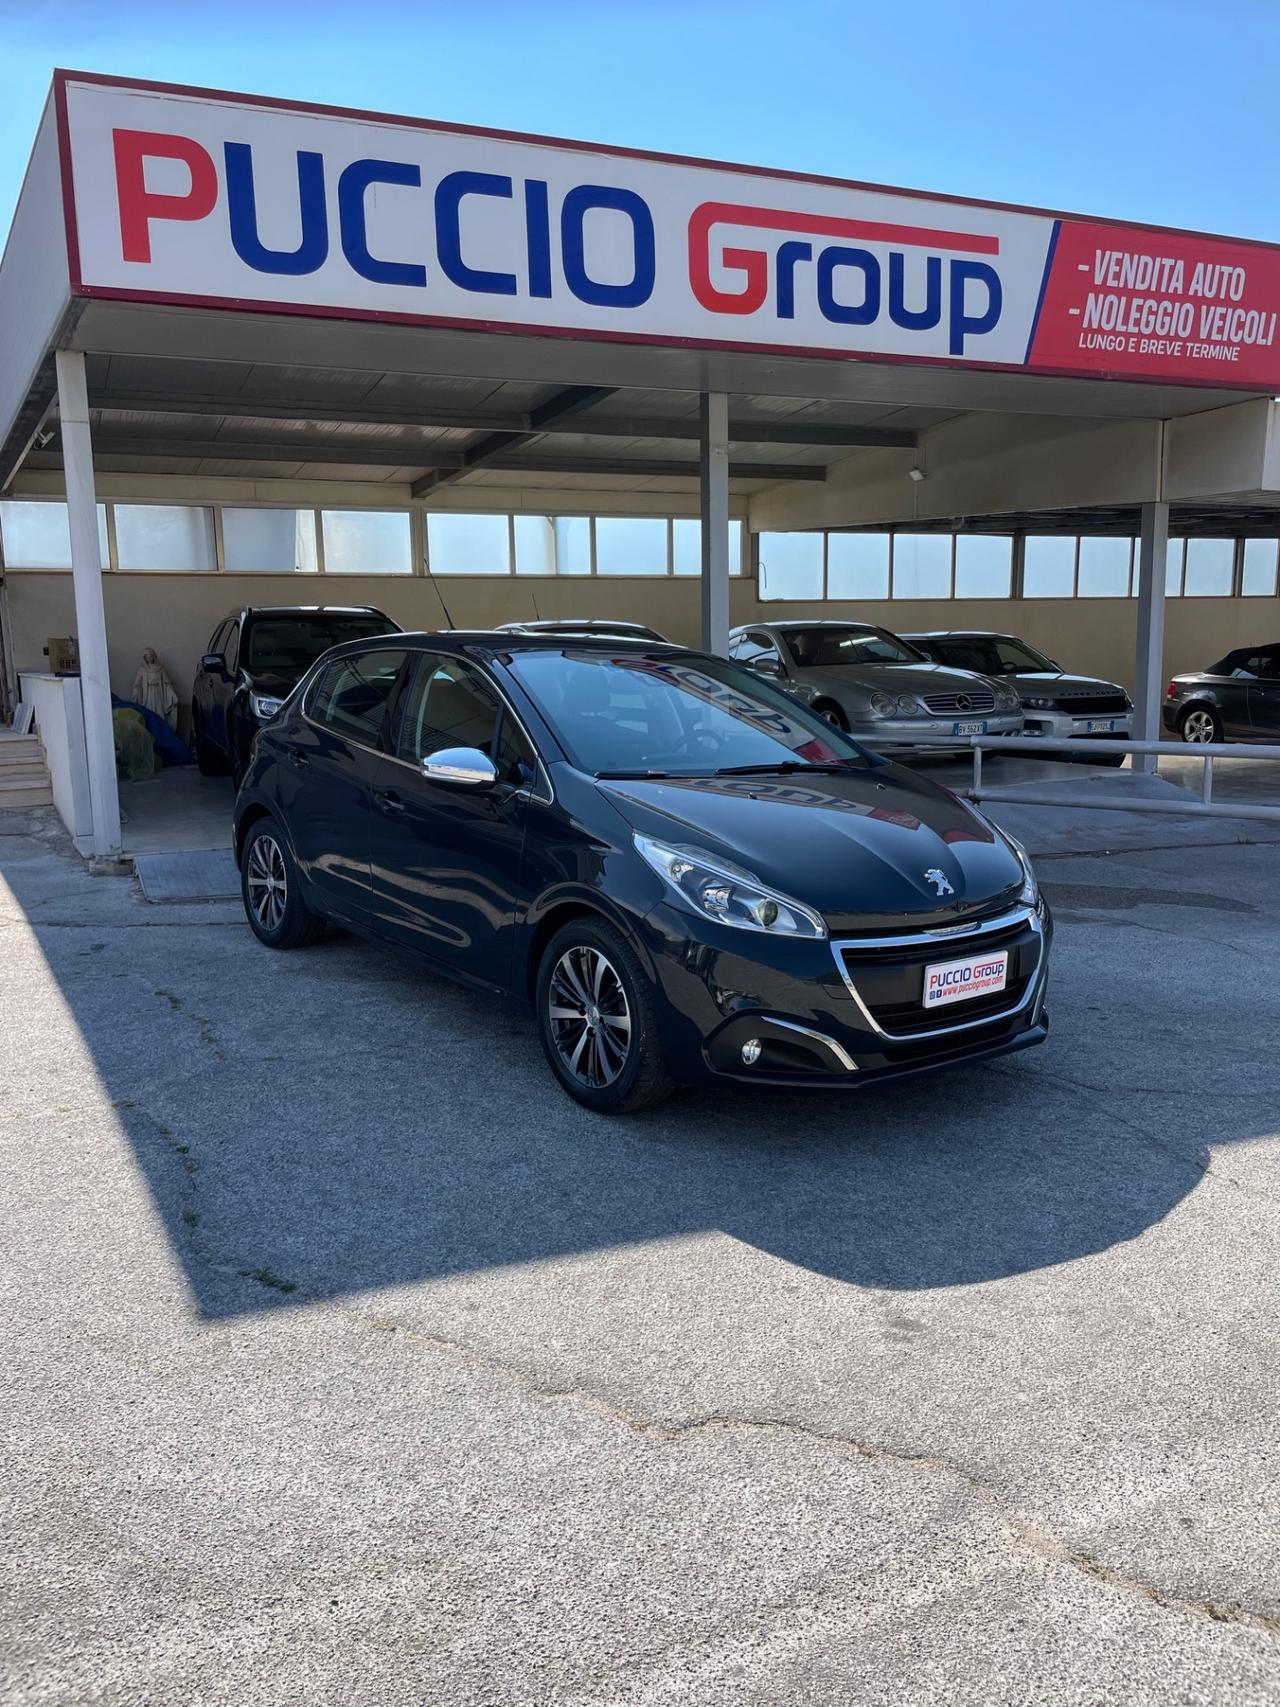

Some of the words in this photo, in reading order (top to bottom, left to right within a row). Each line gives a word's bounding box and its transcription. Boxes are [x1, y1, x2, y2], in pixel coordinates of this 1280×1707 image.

[113, 129, 656, 309] PUCCIO
[1093, 249, 1185, 295] VENDITA
[1188, 262, 1246, 301] AUTO
[1082, 293, 1195, 338] NOLEGGIO
[1199, 305, 1277, 345] VEICOLI
[1078, 333, 1125, 351] LUNGO
[1128, 338, 1137, 352] E
[1139, 339, 1183, 355] BREVE
[1186, 342, 1240, 361] TERMINE
[930, 967, 972, 989] PUCCIO
[943, 976, 1003, 997] www.pucciogroup.com
